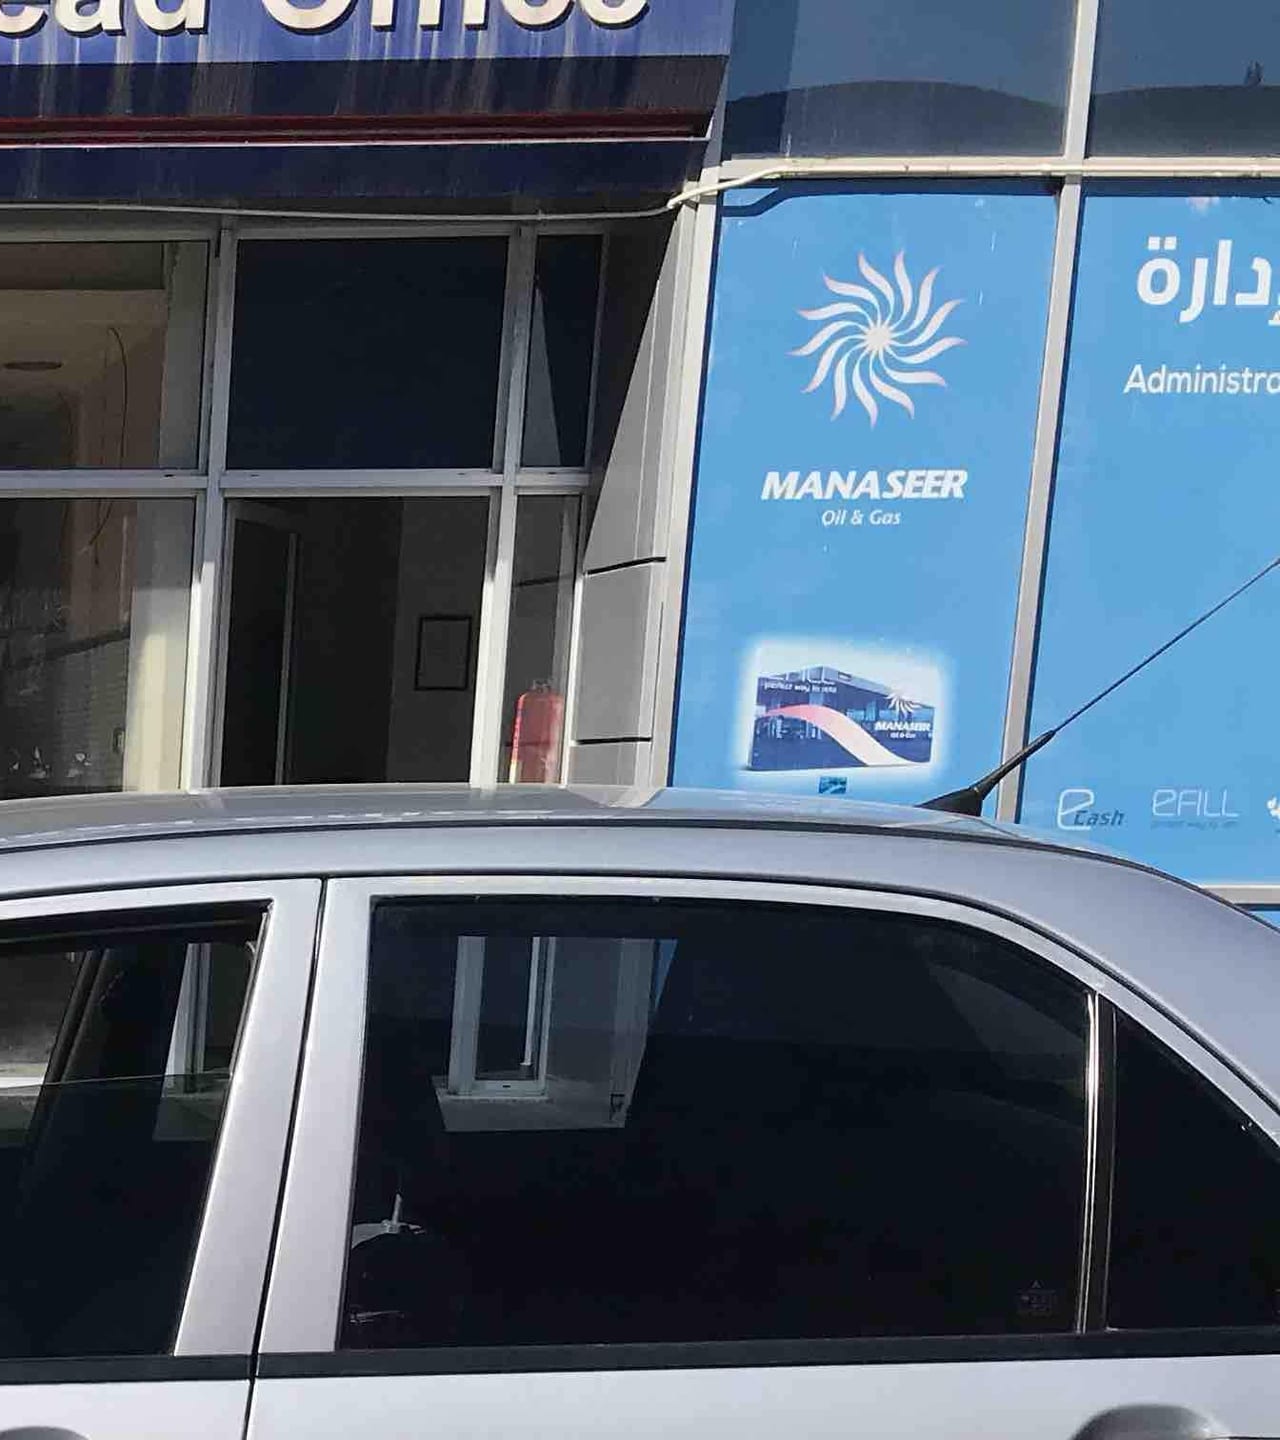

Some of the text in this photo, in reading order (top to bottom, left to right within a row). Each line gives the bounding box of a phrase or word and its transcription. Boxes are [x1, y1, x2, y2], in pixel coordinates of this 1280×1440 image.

[760, 469, 969, 501] MANASEER
[821, 508, 902, 527] Oil & Gas
